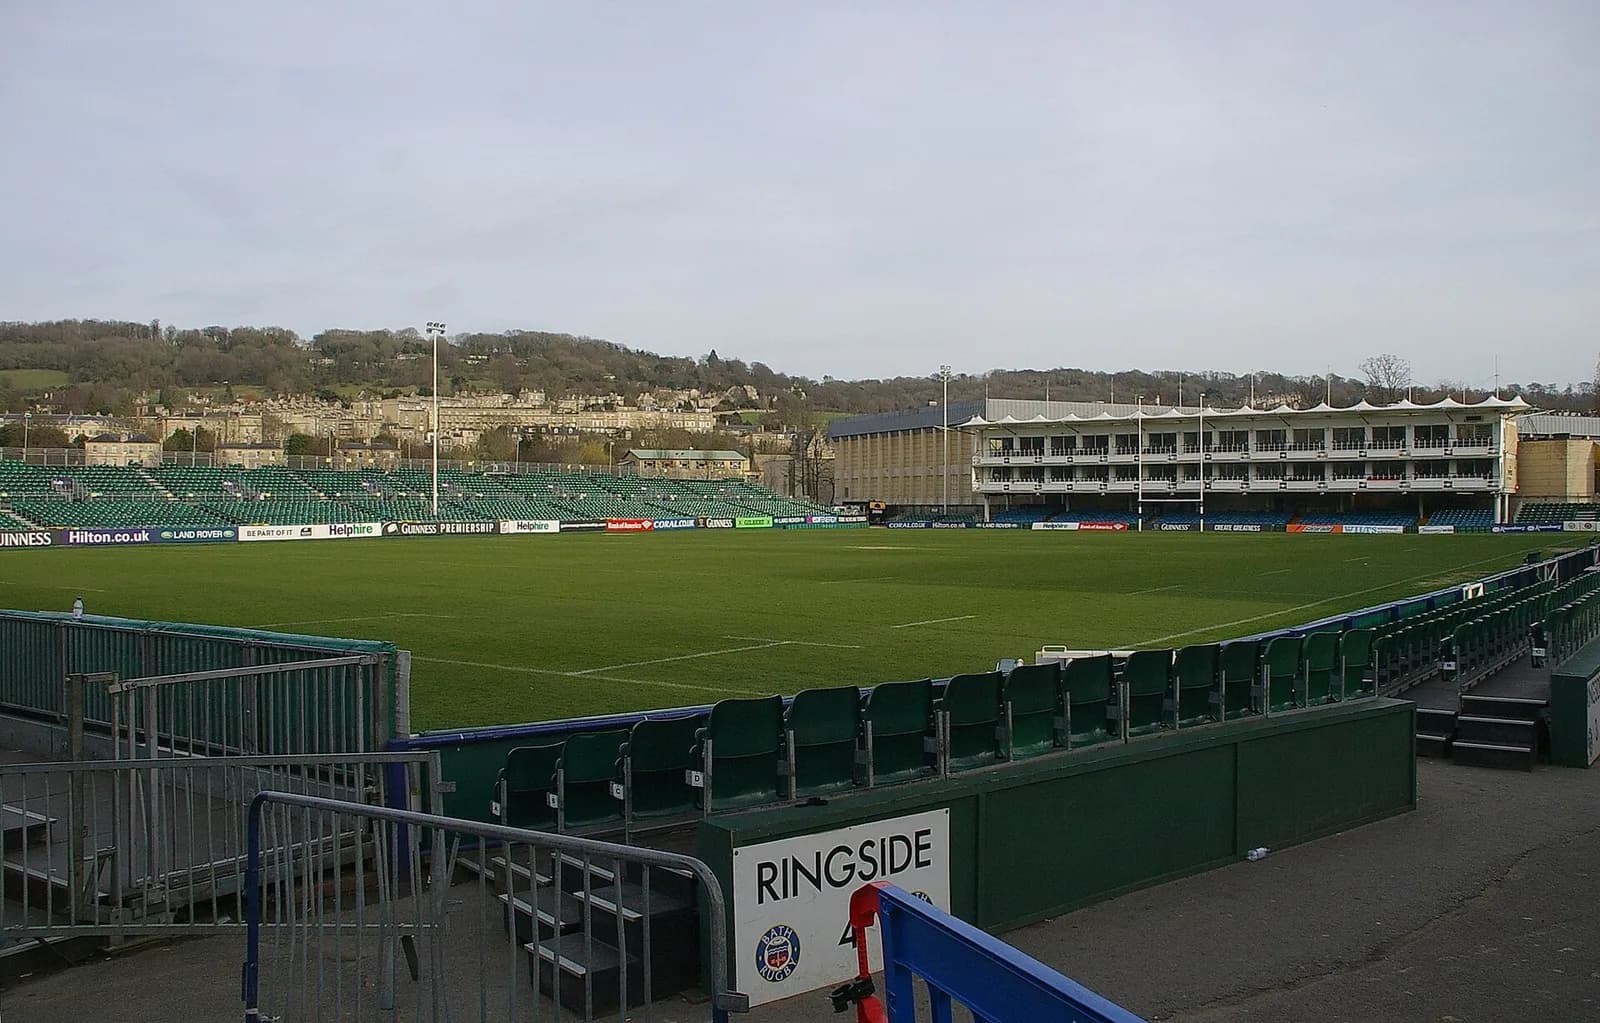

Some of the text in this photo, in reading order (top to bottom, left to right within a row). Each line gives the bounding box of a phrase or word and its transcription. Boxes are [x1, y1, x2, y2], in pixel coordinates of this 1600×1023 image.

[329, 525, 373, 537] Helphire
[401, 523, 494, 534] GUINNESS PREMIERSHIP
[516, 521, 550, 532] Helphire
[69, 530, 150, 543] Hilton.co.uk
[173, 530, 223, 539] LAND ROVER
[256, 529, 274, 537] PART
[757, 828, 932, 905] RINGSIDE
[761, 925, 793, 945] BATH
[760, 957, 797, 981] RUGBY
